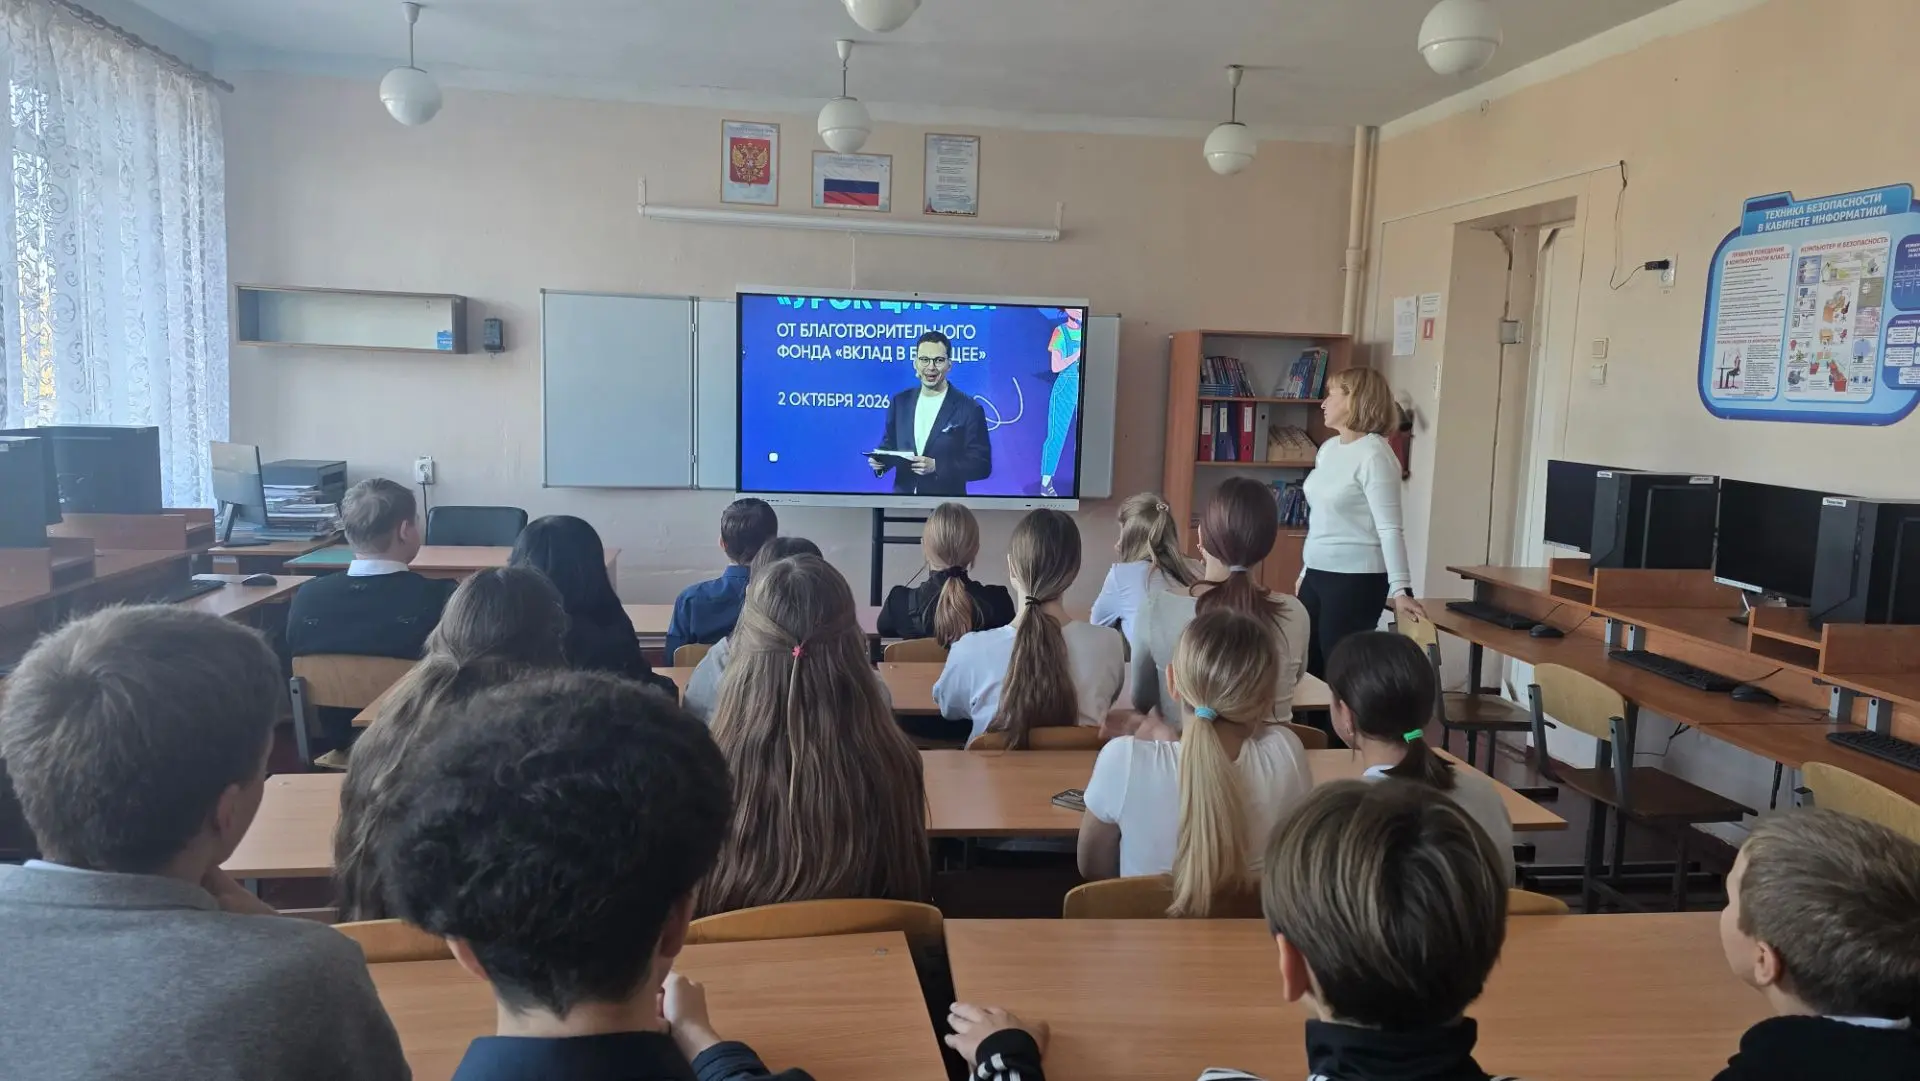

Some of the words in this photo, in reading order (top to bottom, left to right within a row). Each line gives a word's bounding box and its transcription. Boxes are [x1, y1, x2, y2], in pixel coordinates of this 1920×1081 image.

[1765, 206, 1804, 220] ТЕХНИКА
[1806, 193, 1882, 214] БЕЗОПАСНОСТИ
[1757, 223, 1763, 232] В
[1765, 216, 1810, 232] КАБИНЕТЕ
[1811, 205, 1887, 225] ИНФОРМАТИКИ
[1842, 236, 1888, 248] БЕЗОПАСНОСТЬ
[776, 322, 797, 338] ОТ
[776, 344, 832, 361] ФОНДА
[835, 345, 893, 363] «ВКЛАД
[896, 346, 906, 361] В
[909, 346, 987, 364] БЩЕЕ»
[777, 391, 786, 406] 2
[788, 391, 853, 408] ОКТЯБРЯ
[856, 393, 891, 409] 2026
